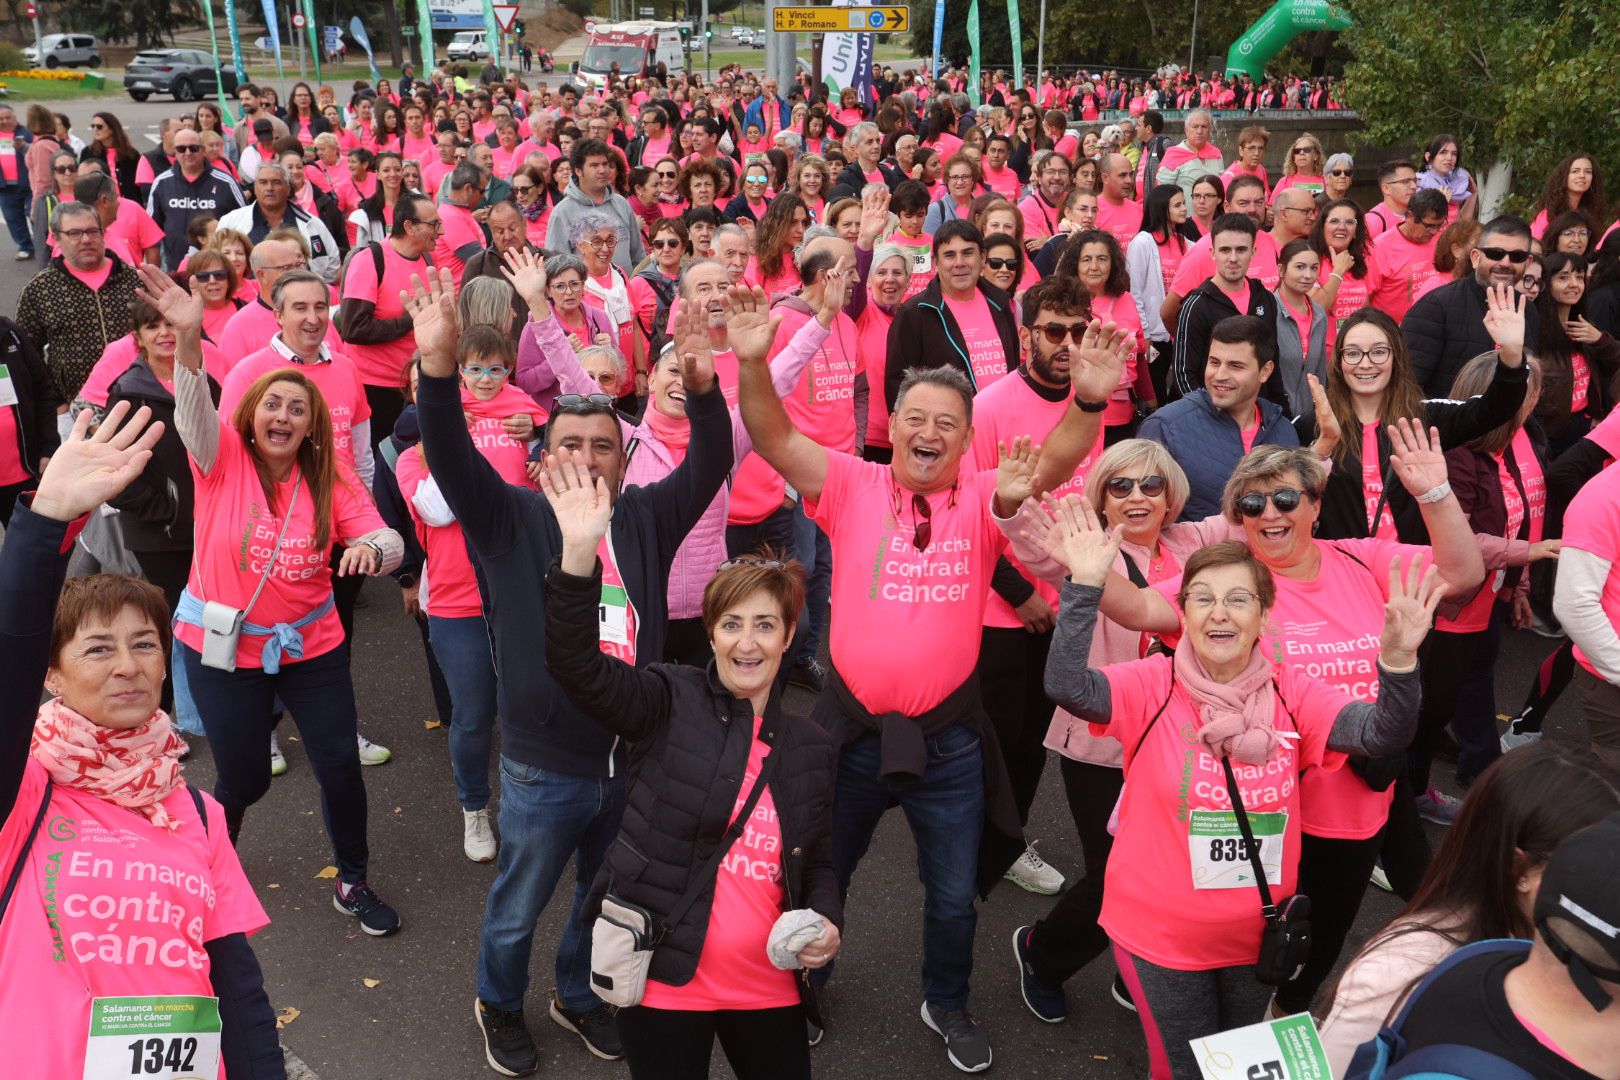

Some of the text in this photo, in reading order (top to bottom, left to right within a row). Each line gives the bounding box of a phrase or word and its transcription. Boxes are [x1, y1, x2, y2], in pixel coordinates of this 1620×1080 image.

[776, 11, 815, 19] H. Vincci
[801, 20, 837, 28] Romano
[168, 197, 216, 209] adidas
[974, 337, 1001, 347] march
[970, 351, 1000, 362] ontra
[814, 362, 826, 373] En
[975, 361, 1008, 377] ánce
[815, 386, 855, 402] cánce
[255, 524, 274, 541] En
[890, 536, 910, 553] En
[308, 550, 324, 564] el
[885, 555, 970, 577] contra el
[881, 579, 970, 603] cáncer
[1285, 640, 1313, 655] En
[1316, 633, 1380, 654] march
[1199, 752, 1223, 777] En
[1281, 772, 1295, 798] el
[68, 850, 217, 910] En marcha
[44, 850, 66, 963] SALAMANCA
[63, 891, 186, 930] contra
[70, 922, 208, 970] cánce
[102, 1003, 195, 1014] Salamanca en marcha
[102, 1013, 173, 1023] contra el cáncer
[128, 1037, 198, 1075] 1342
